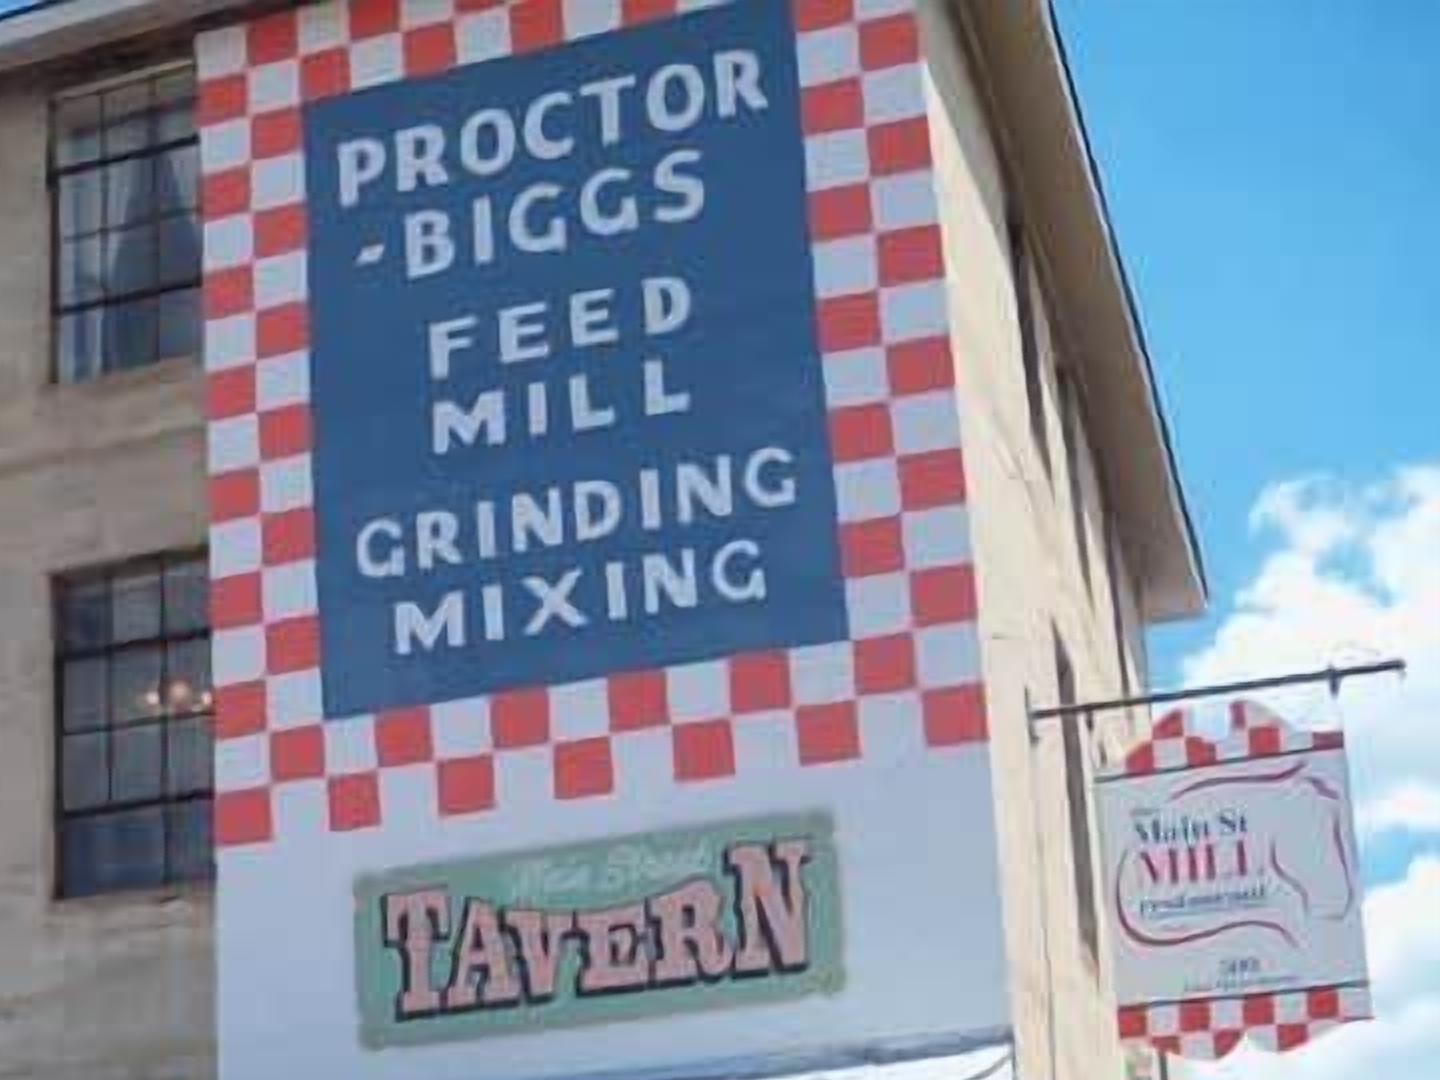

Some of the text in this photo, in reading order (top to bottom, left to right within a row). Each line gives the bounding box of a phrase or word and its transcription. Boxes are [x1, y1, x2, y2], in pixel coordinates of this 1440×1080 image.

[337, 49, 768, 206] PROCTOR
[356, 150, 705, 281] -BIGGS
[427, 276, 692, 380] FEED
[432, 359, 691, 455] MILL
[355, 446, 797, 578] GRINDING
[393, 539, 766, 656] MIXING
[380, 836, 814, 1022] TAVERN
